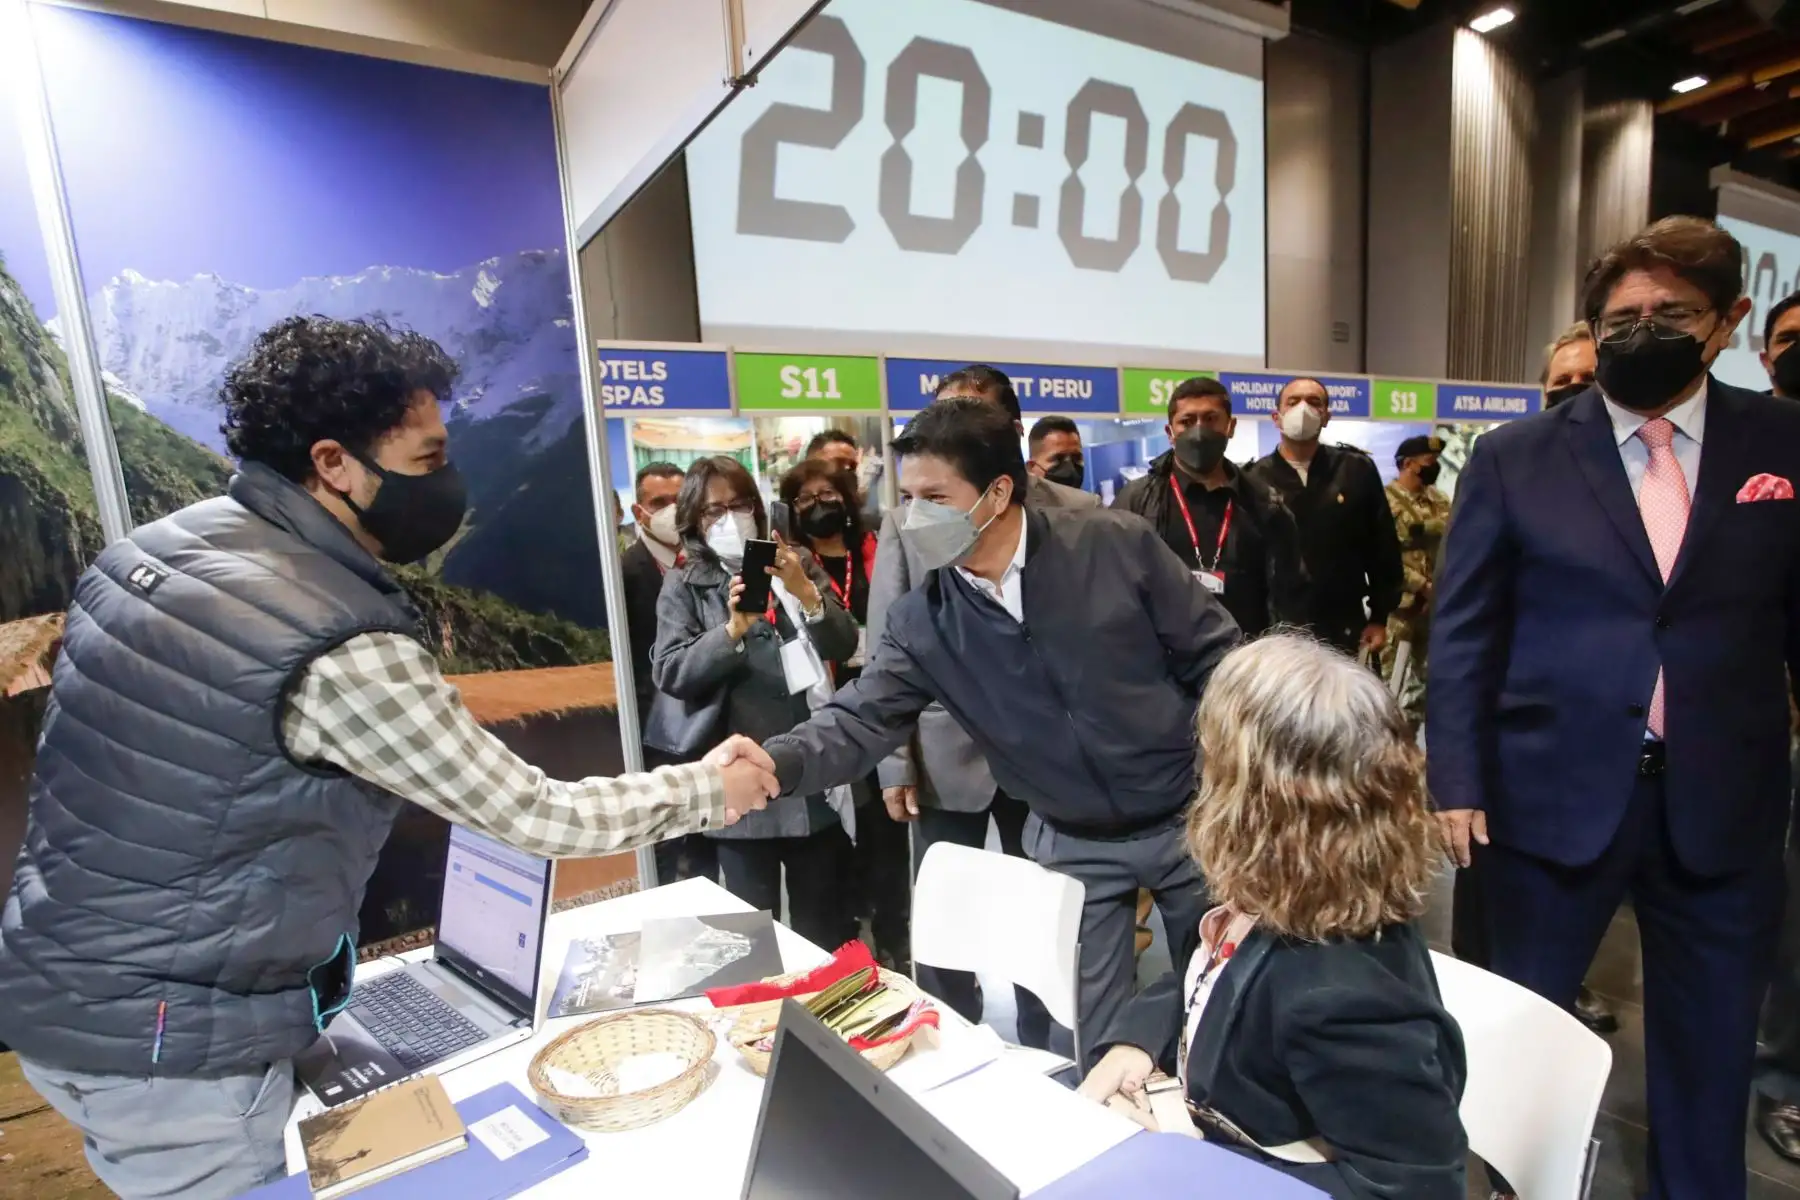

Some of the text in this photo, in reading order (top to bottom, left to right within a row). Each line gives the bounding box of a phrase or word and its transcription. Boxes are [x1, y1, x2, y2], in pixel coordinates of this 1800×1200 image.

[736, 12, 1238, 284] 20:00
[780, 365, 841, 399] S11
[1039, 378, 1093, 399] PERU
[1149, 378, 1185, 406] S1
[1231, 381, 1274, 394] HOLIDAY
[602, 384, 665, 406] SPAS
[1246, 397, 1278, 410] HOTEL
[1390, 390, 1417, 413] S13
[1453, 395, 1527, 414] ATSA AIRLINES
